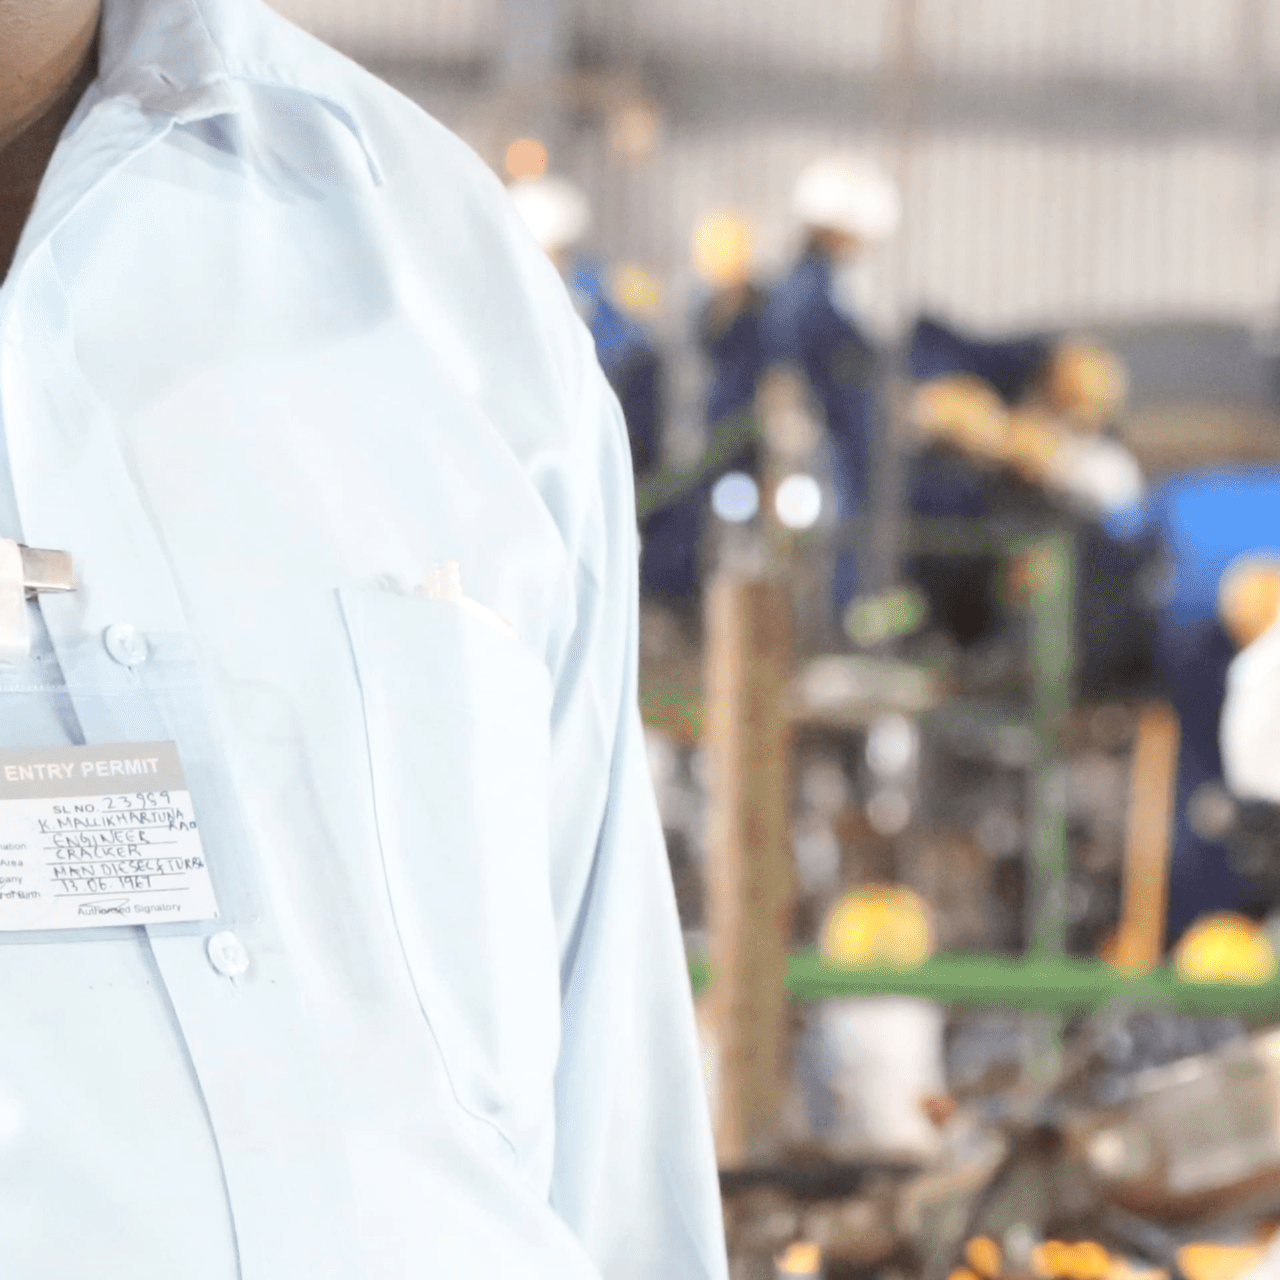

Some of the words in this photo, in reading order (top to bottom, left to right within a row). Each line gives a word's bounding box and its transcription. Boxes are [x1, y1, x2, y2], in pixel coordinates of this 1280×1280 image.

[4, 762, 75, 782] ENTRY
[80, 757, 160, 777] PERMIT
[53, 805, 71, 814] SL
[53, 830, 151, 848] ENGINEER
[0, 858, 24, 867] Area
[134, 903, 182, 914] Signatory
